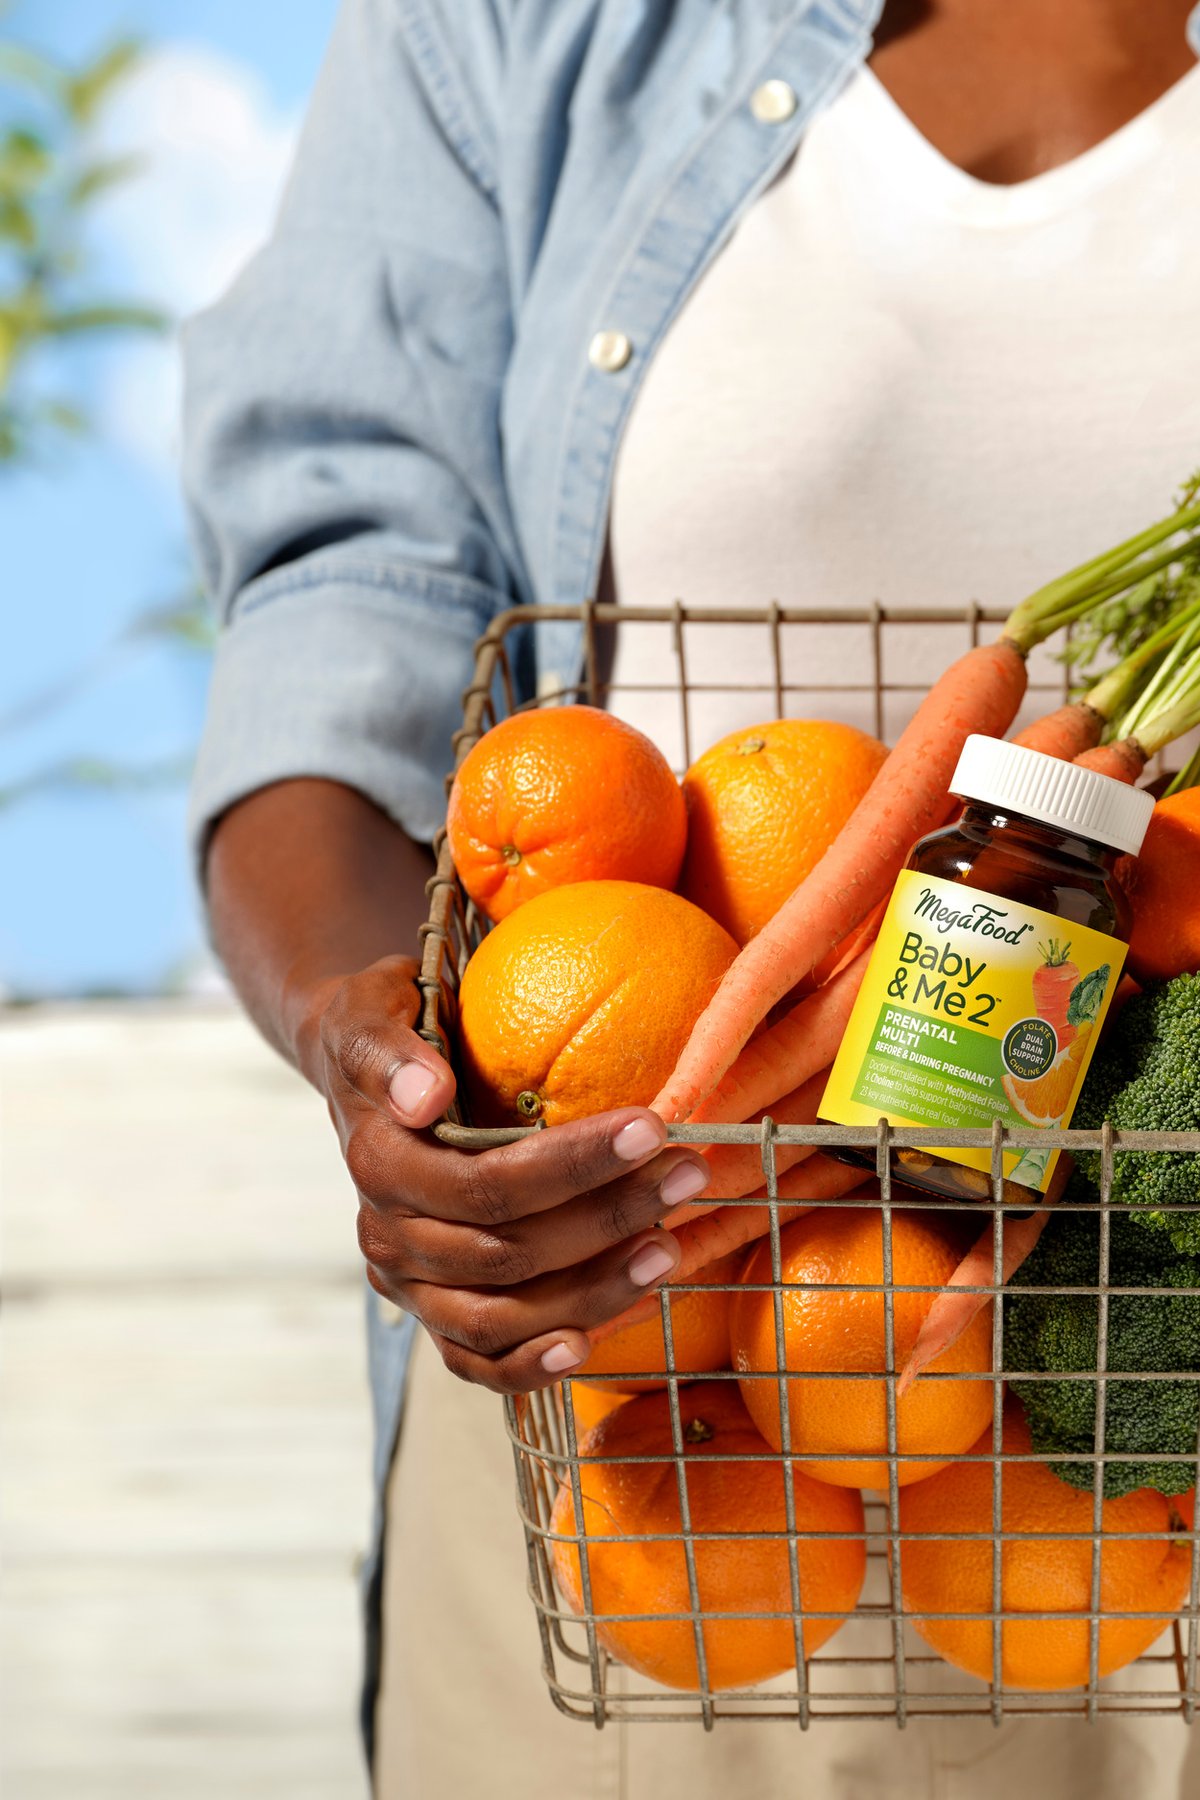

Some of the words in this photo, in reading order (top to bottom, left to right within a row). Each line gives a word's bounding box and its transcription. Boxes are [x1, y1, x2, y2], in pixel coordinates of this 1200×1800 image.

[899, 931, 987, 988] Baby
[887, 966, 909, 1000] &
[912, 973, 966, 1017] Me
[879, 1024, 921, 1048] MULTI
[884, 1009, 958, 1045] PRENATAL
[1022, 1023, 1052, 1039] FOLATE
[1025, 1033, 1044, 1046] DUAL
[874, 1040, 902, 1058] BEFORE
[901, 1049, 909, 1060] &
[909, 1051, 943, 1071] DURING
[941, 1063, 996, 1088] PREGNANCY
[1010, 1058, 1041, 1076] CHOLINE
[1020, 1041, 1044, 1055] BRAIN
[859, 1085, 869, 1097] 23
[868, 1088, 879, 1101] key
[878, 1093, 909, 1110] nutrients
[909, 1103, 925, 1116] plus
[925, 1108, 941, 1120] real
[940, 1112, 960, 1127] food
[868, 1059, 888, 1073] Doctor
[890, 1064, 928, 1086] formulated
[927, 1080, 945, 1092] with
[944, 1083, 987, 1107] Methylated
[986, 1099, 1010, 1114] Folate
[870, 1073, 895, 1089] Choline
[894, 1081, 903, 1091] to
[901, 1084, 919, 1098] help
[919, 1090, 949, 1108] support
[972, 1108, 993, 1121] brain
